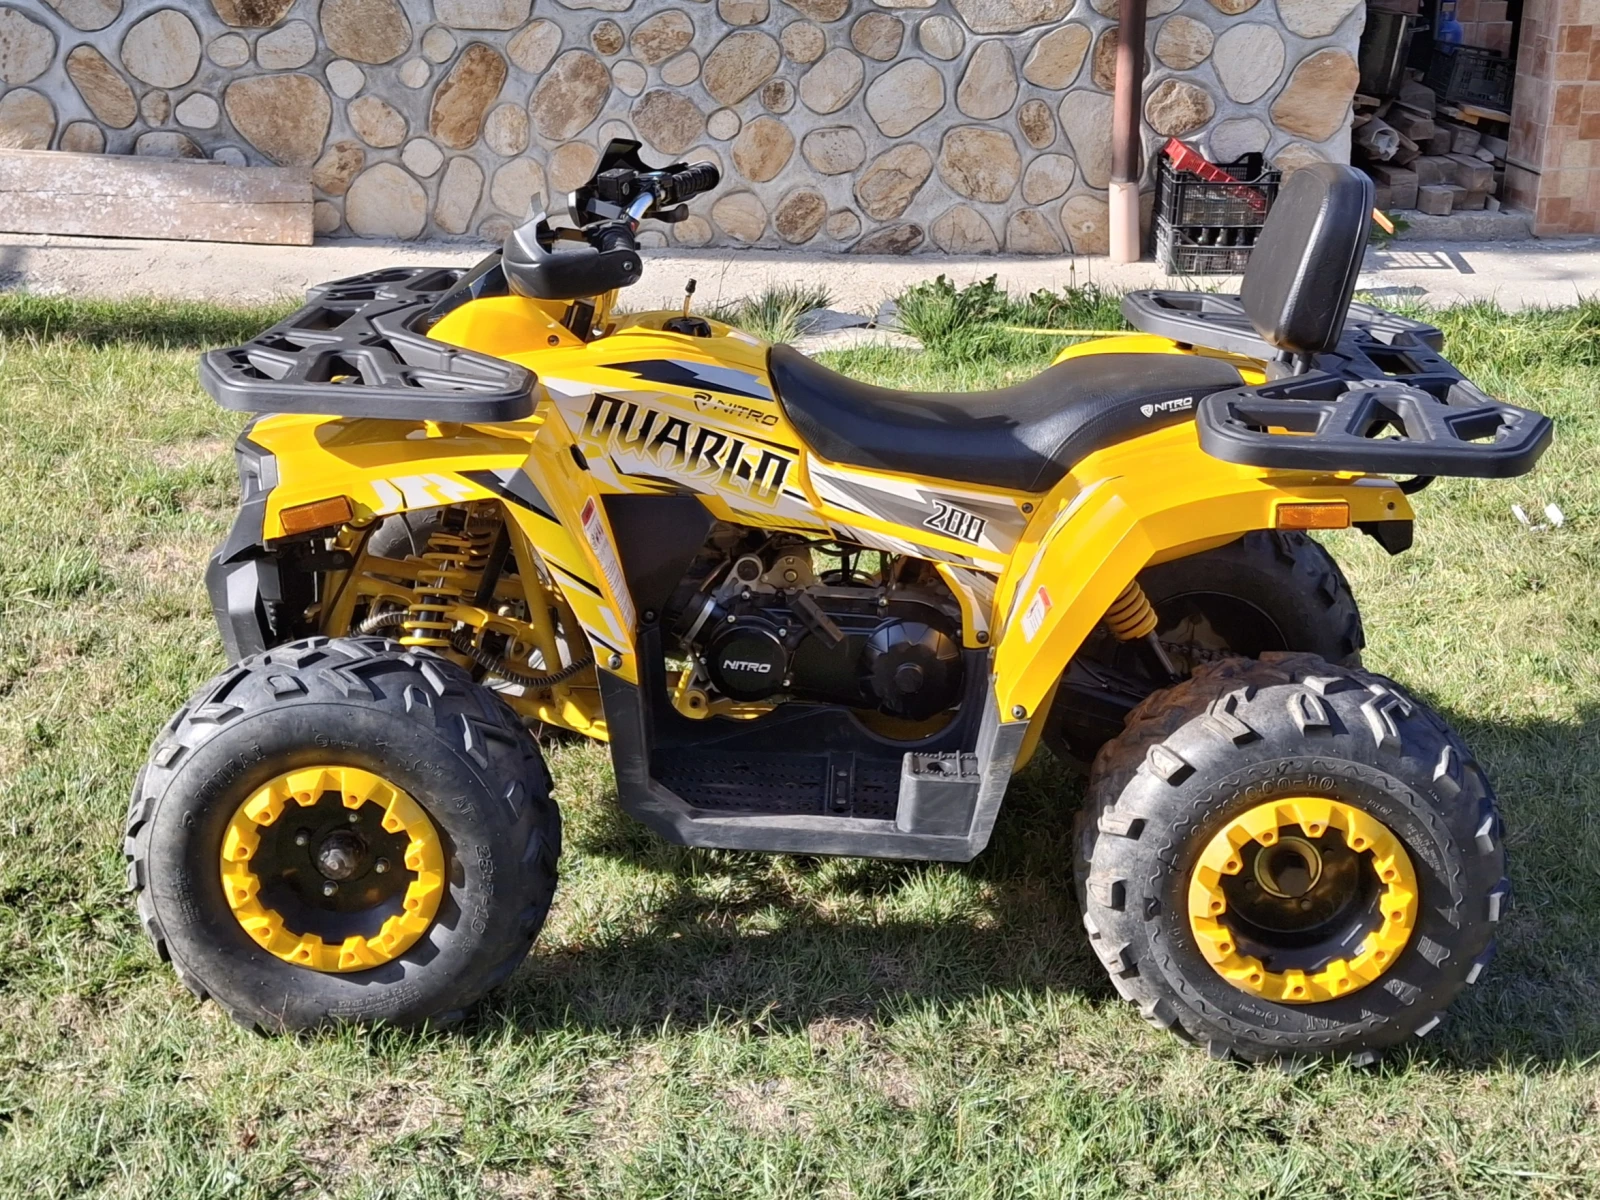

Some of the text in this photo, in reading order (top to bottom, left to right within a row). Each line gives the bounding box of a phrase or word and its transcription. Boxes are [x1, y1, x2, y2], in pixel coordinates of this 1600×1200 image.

[714, 400, 779, 426] NITRO
[1154, 396, 1193, 413] NITRO
[923, 500, 987, 545] 200
[723, 659, 771, 673] NITRO
